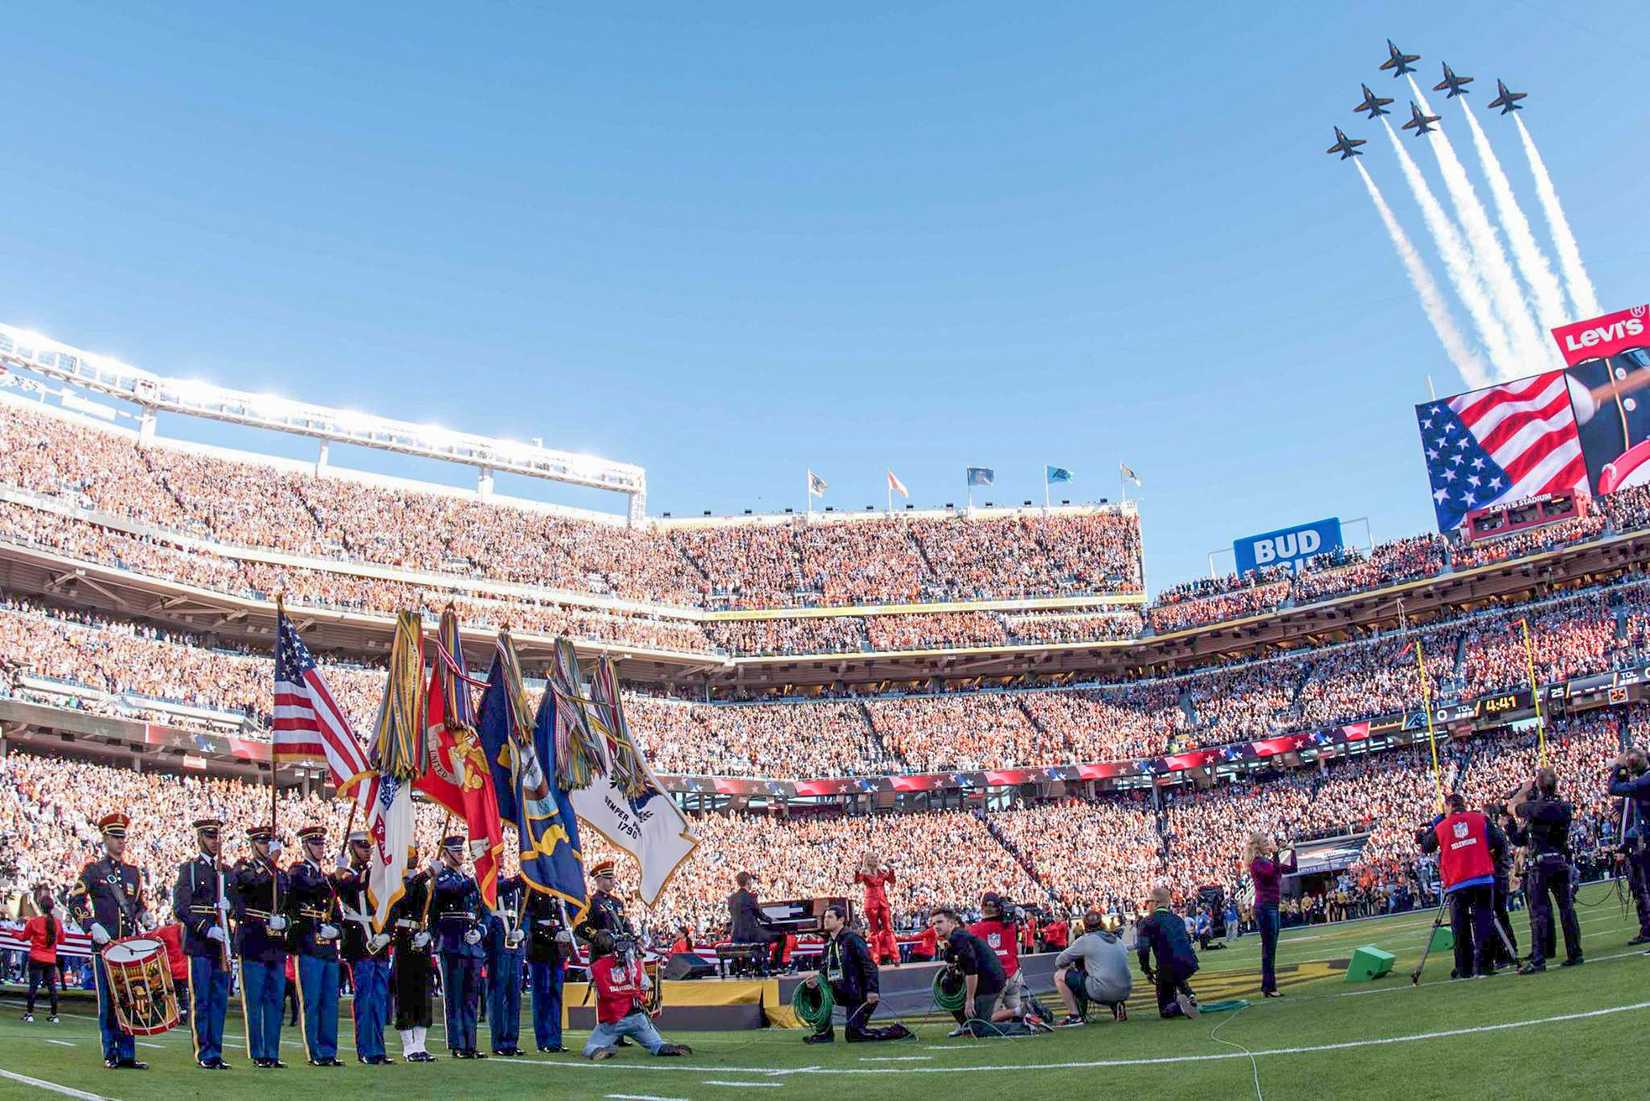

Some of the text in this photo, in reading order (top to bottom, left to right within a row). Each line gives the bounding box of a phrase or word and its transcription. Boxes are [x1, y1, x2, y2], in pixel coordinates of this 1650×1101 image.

[1518, 494, 1551, 506] STADIUM
[1253, 529, 1321, 565] BUD
[1550, 687, 1564, 698] 25
[1610, 689, 1626, 701] 25
[1485, 695, 1517, 712] 4:41
[605, 796, 629, 822] SEMPER
[617, 821, 637, 839] 1790
